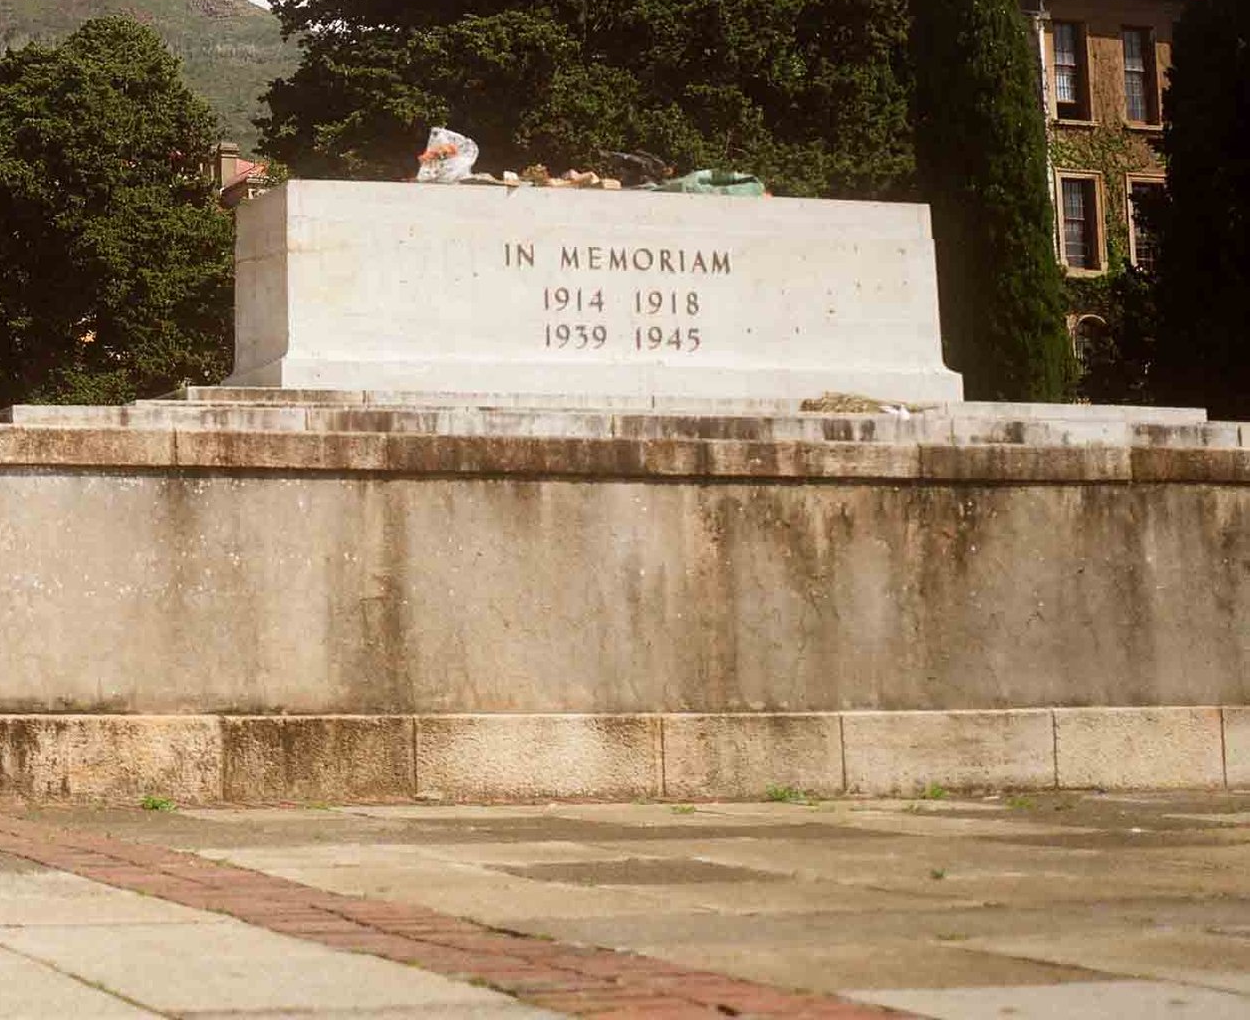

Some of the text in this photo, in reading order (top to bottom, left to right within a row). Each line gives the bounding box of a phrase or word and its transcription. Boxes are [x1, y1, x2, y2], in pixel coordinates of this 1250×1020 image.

[504, 243, 732, 274] IN MEMORIAM
[544, 287, 700, 315] 1914 1918
[545, 324, 701, 352] 1939 1945
